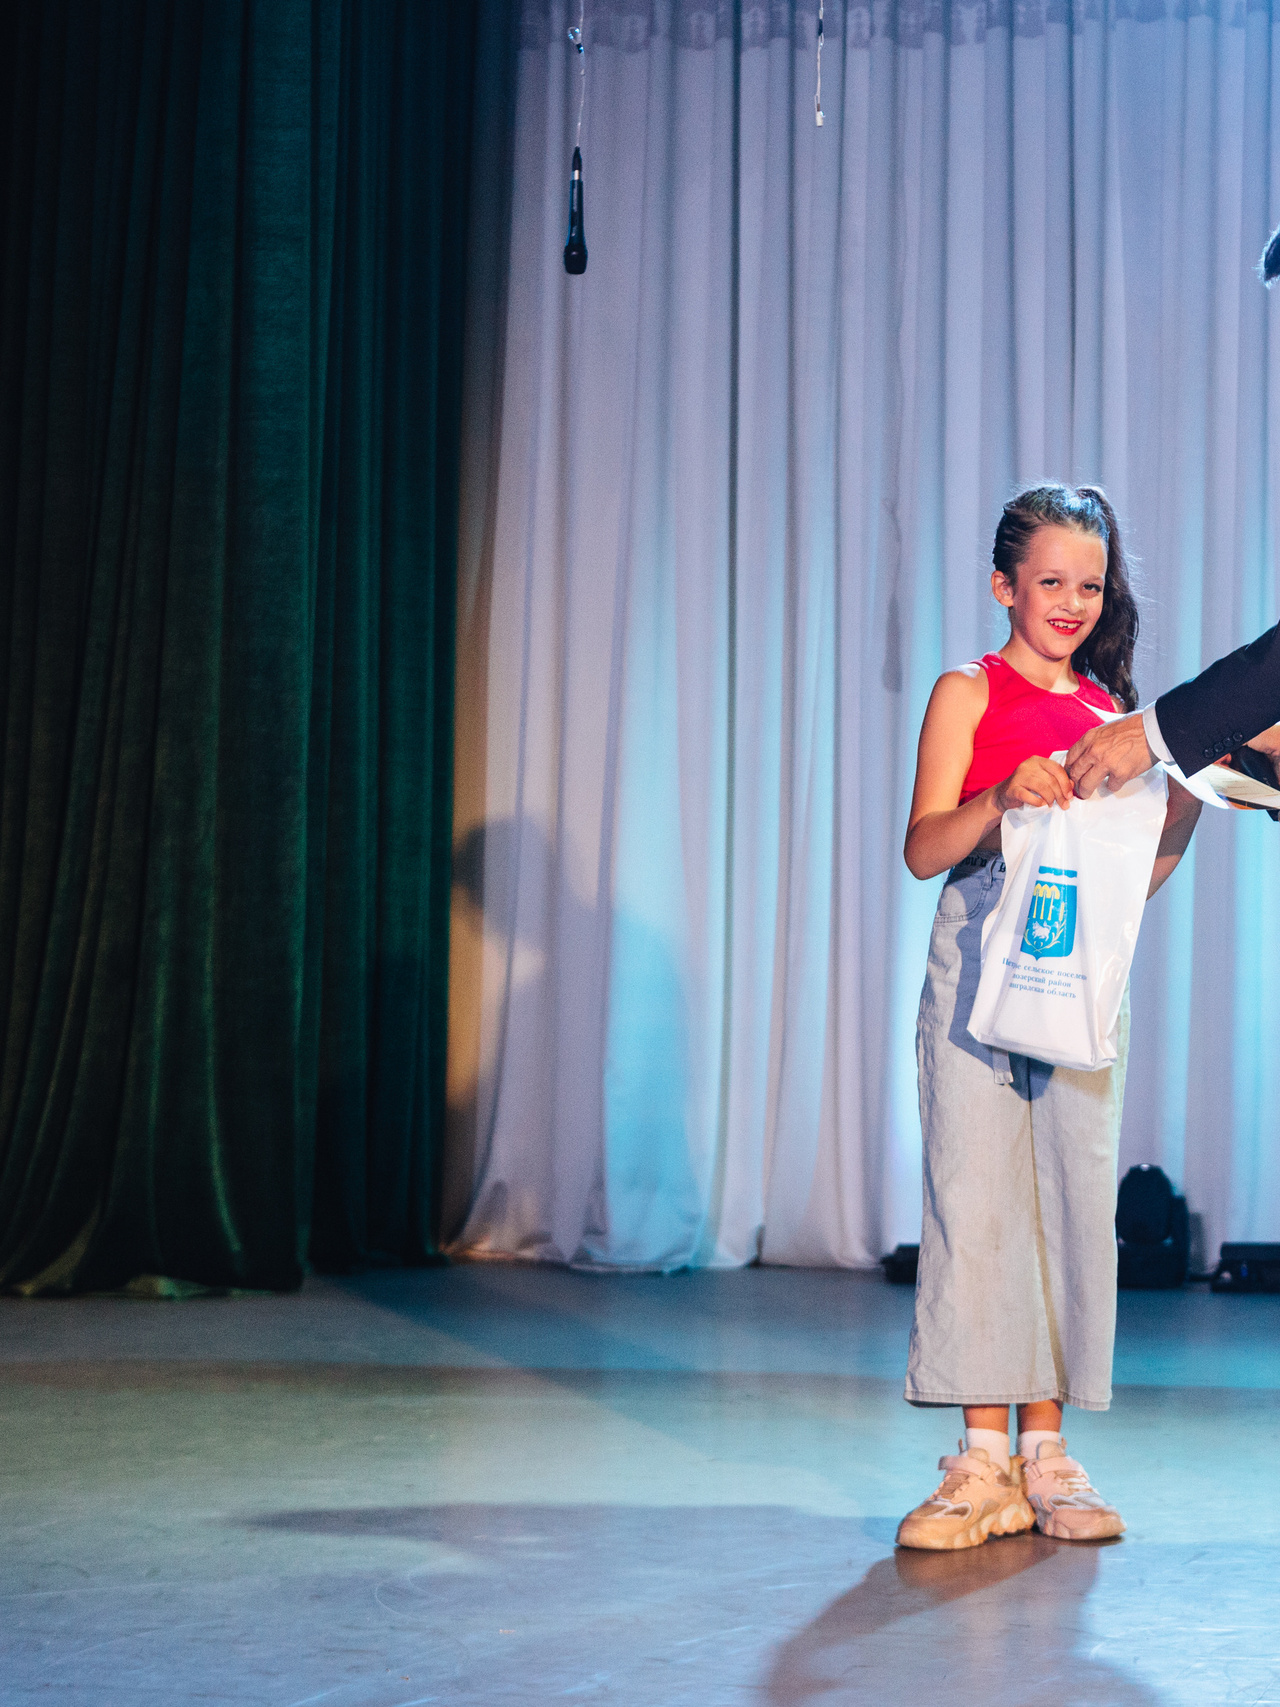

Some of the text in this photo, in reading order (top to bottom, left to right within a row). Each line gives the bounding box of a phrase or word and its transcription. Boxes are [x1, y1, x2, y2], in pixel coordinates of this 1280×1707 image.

[1023, 964, 1054, 975] сельское
[1048, 979, 1072, 988] район
[1046, 988, 1077, 999] область
